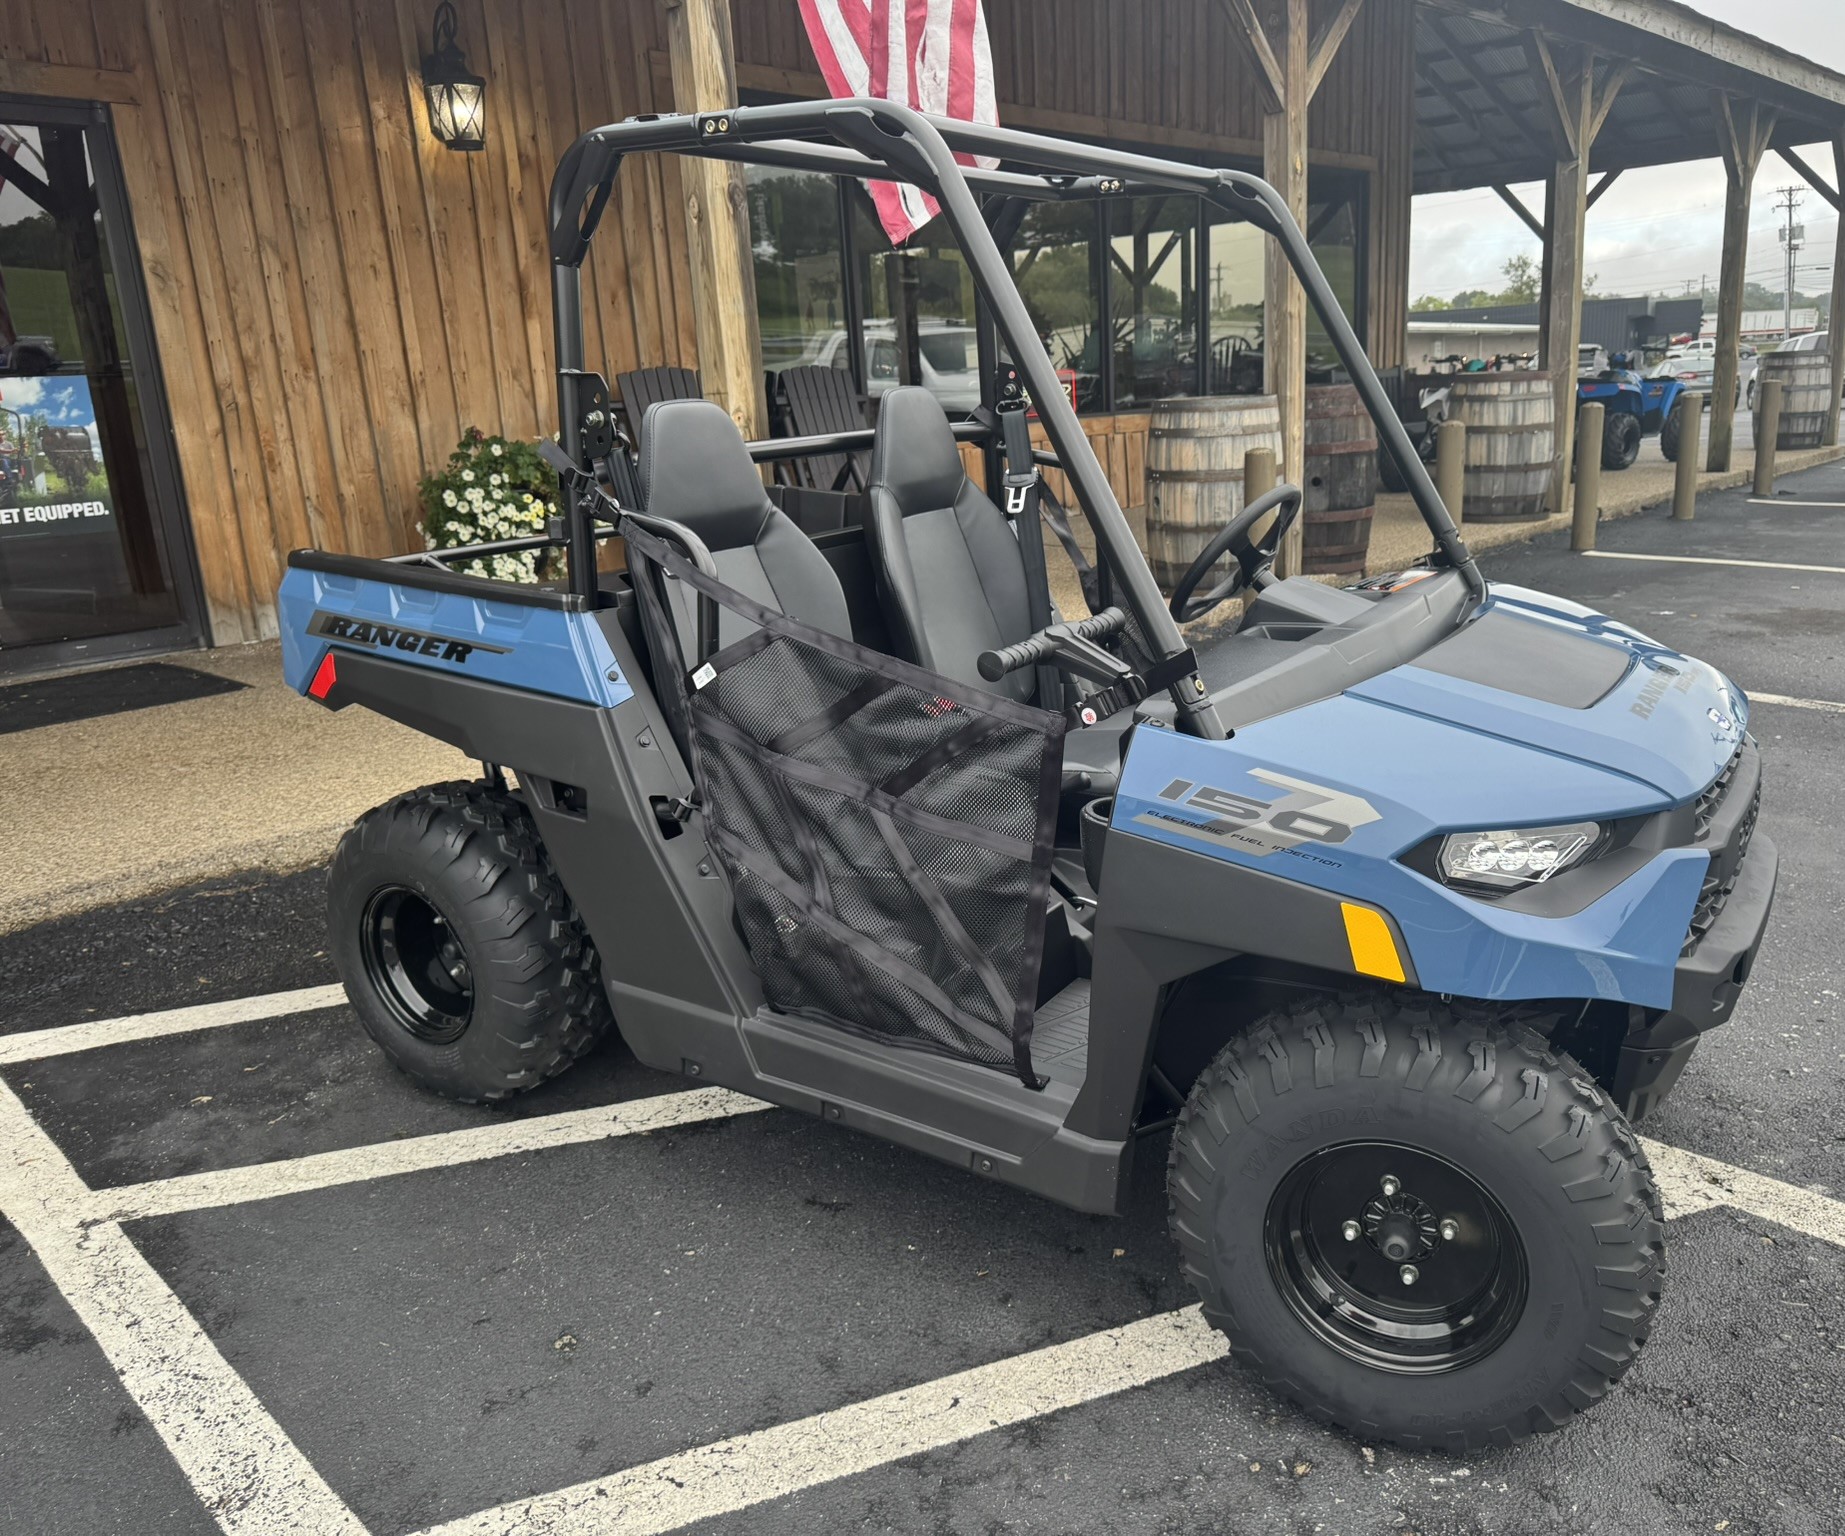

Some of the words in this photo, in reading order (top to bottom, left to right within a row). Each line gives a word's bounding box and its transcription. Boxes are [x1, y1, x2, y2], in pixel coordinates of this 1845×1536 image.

[0, 508, 20, 525] ET
[23, 501, 110, 522] EQUIPPED.
[326, 616, 474, 664] RANGER
[1146, 809, 1226, 836] ELECTRONIC
[1230, 833, 1265, 848] FUEL
[1271, 844, 1343, 869] INJECTION
[1157, 777, 1353, 844] 150
[1240, 1105, 1382, 1181] WANDA
